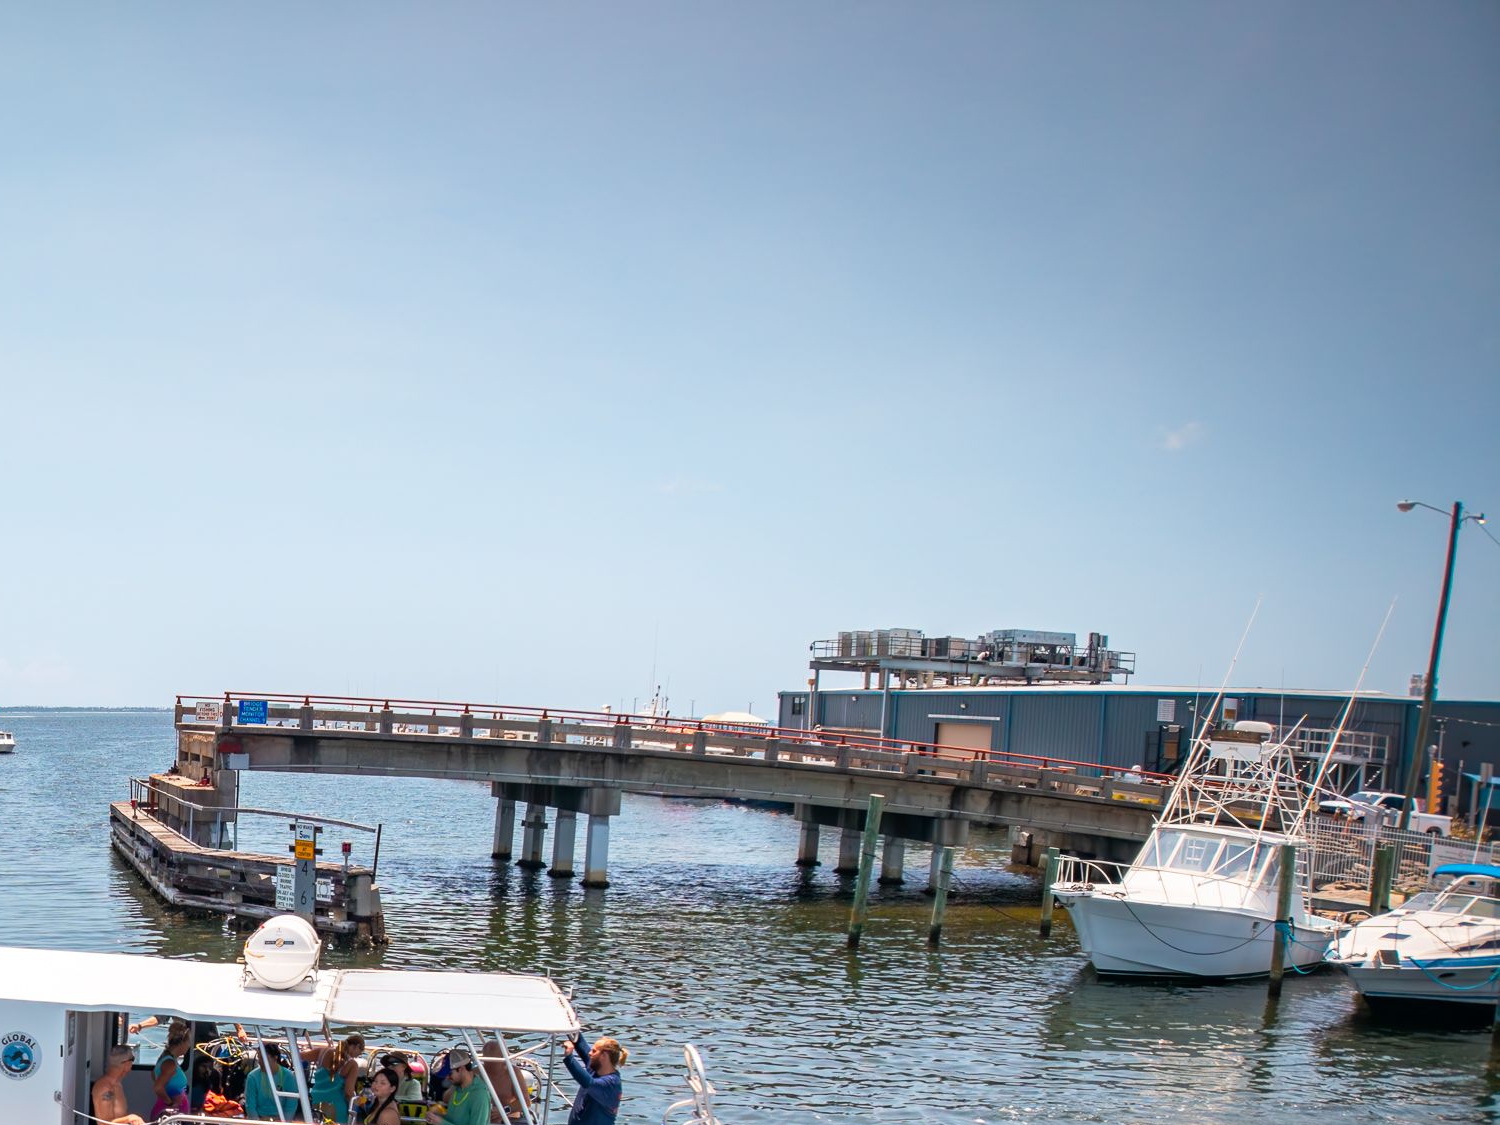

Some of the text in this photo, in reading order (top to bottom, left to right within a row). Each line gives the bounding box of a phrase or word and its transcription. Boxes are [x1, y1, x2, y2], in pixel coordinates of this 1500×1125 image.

[299, 831, 303, 839] 5
[301, 861, 308, 876] 4
[300, 890, 307, 905] 6
[1, 1033, 36, 1050] GLOBAL
